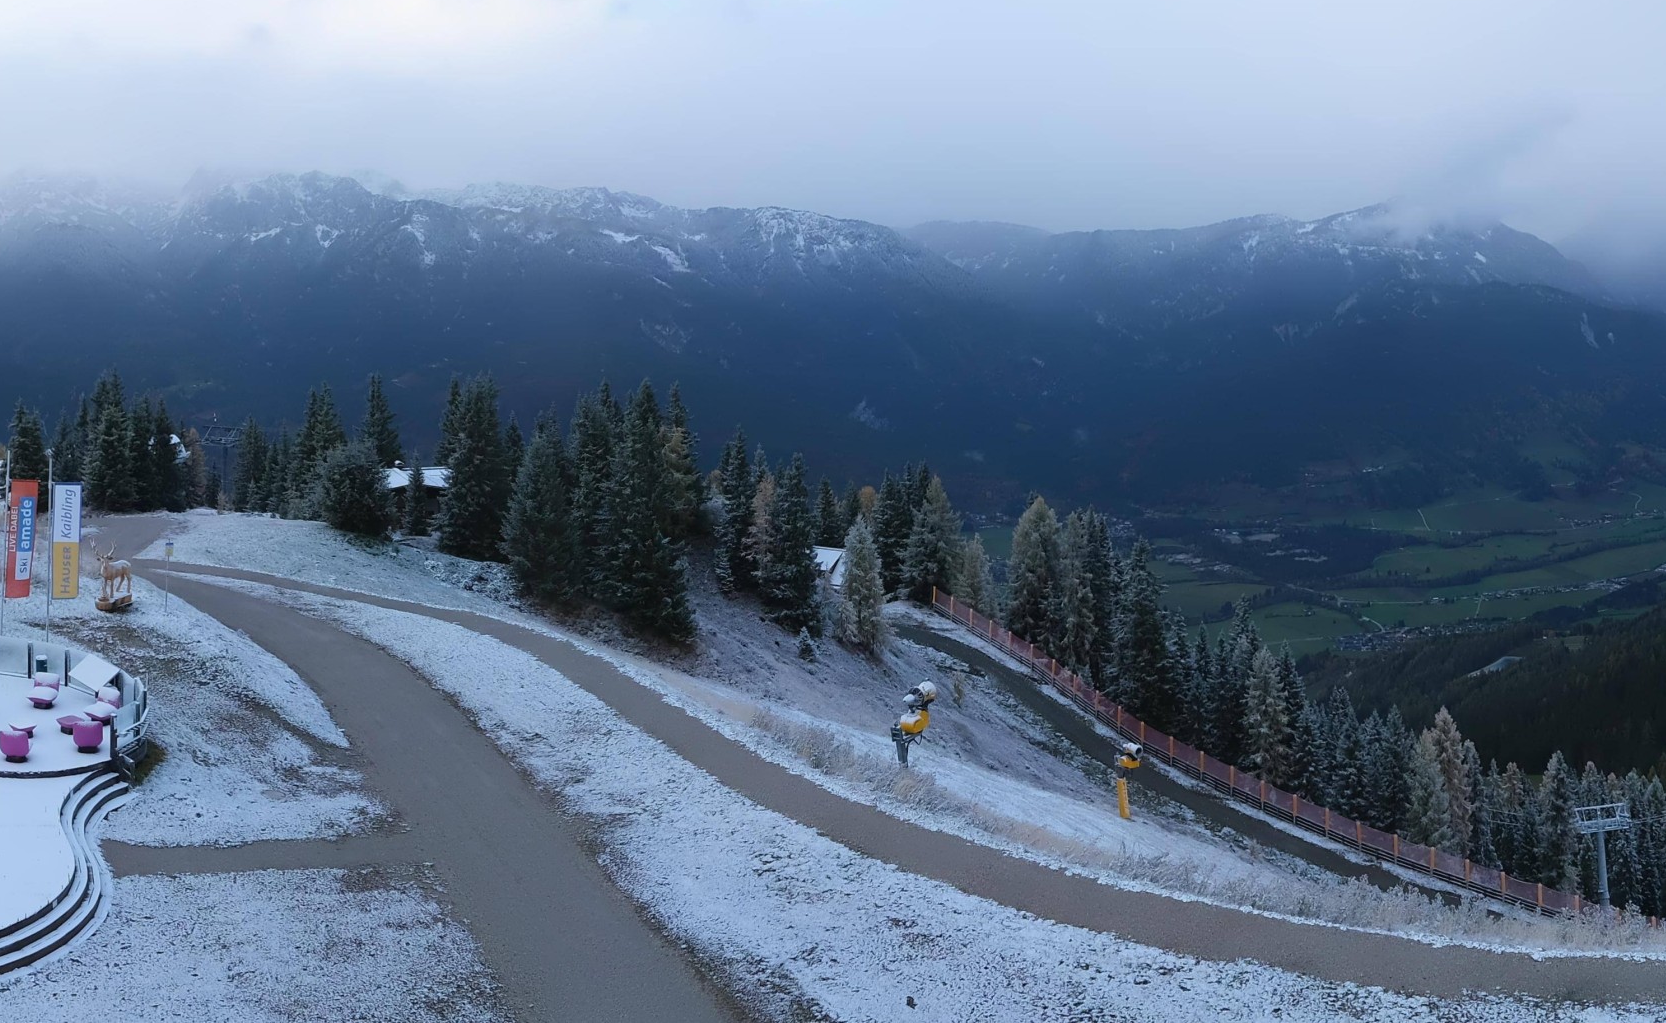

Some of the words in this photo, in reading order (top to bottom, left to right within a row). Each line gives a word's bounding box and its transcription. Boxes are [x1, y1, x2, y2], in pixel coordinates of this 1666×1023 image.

[10, 506, 18, 533] DABEI
[61, 489, 76, 538] Kaibling
[9, 534, 17, 552] LIVE
[19, 557, 28, 574] Ski
[60, 545, 72, 594] HAUSER
